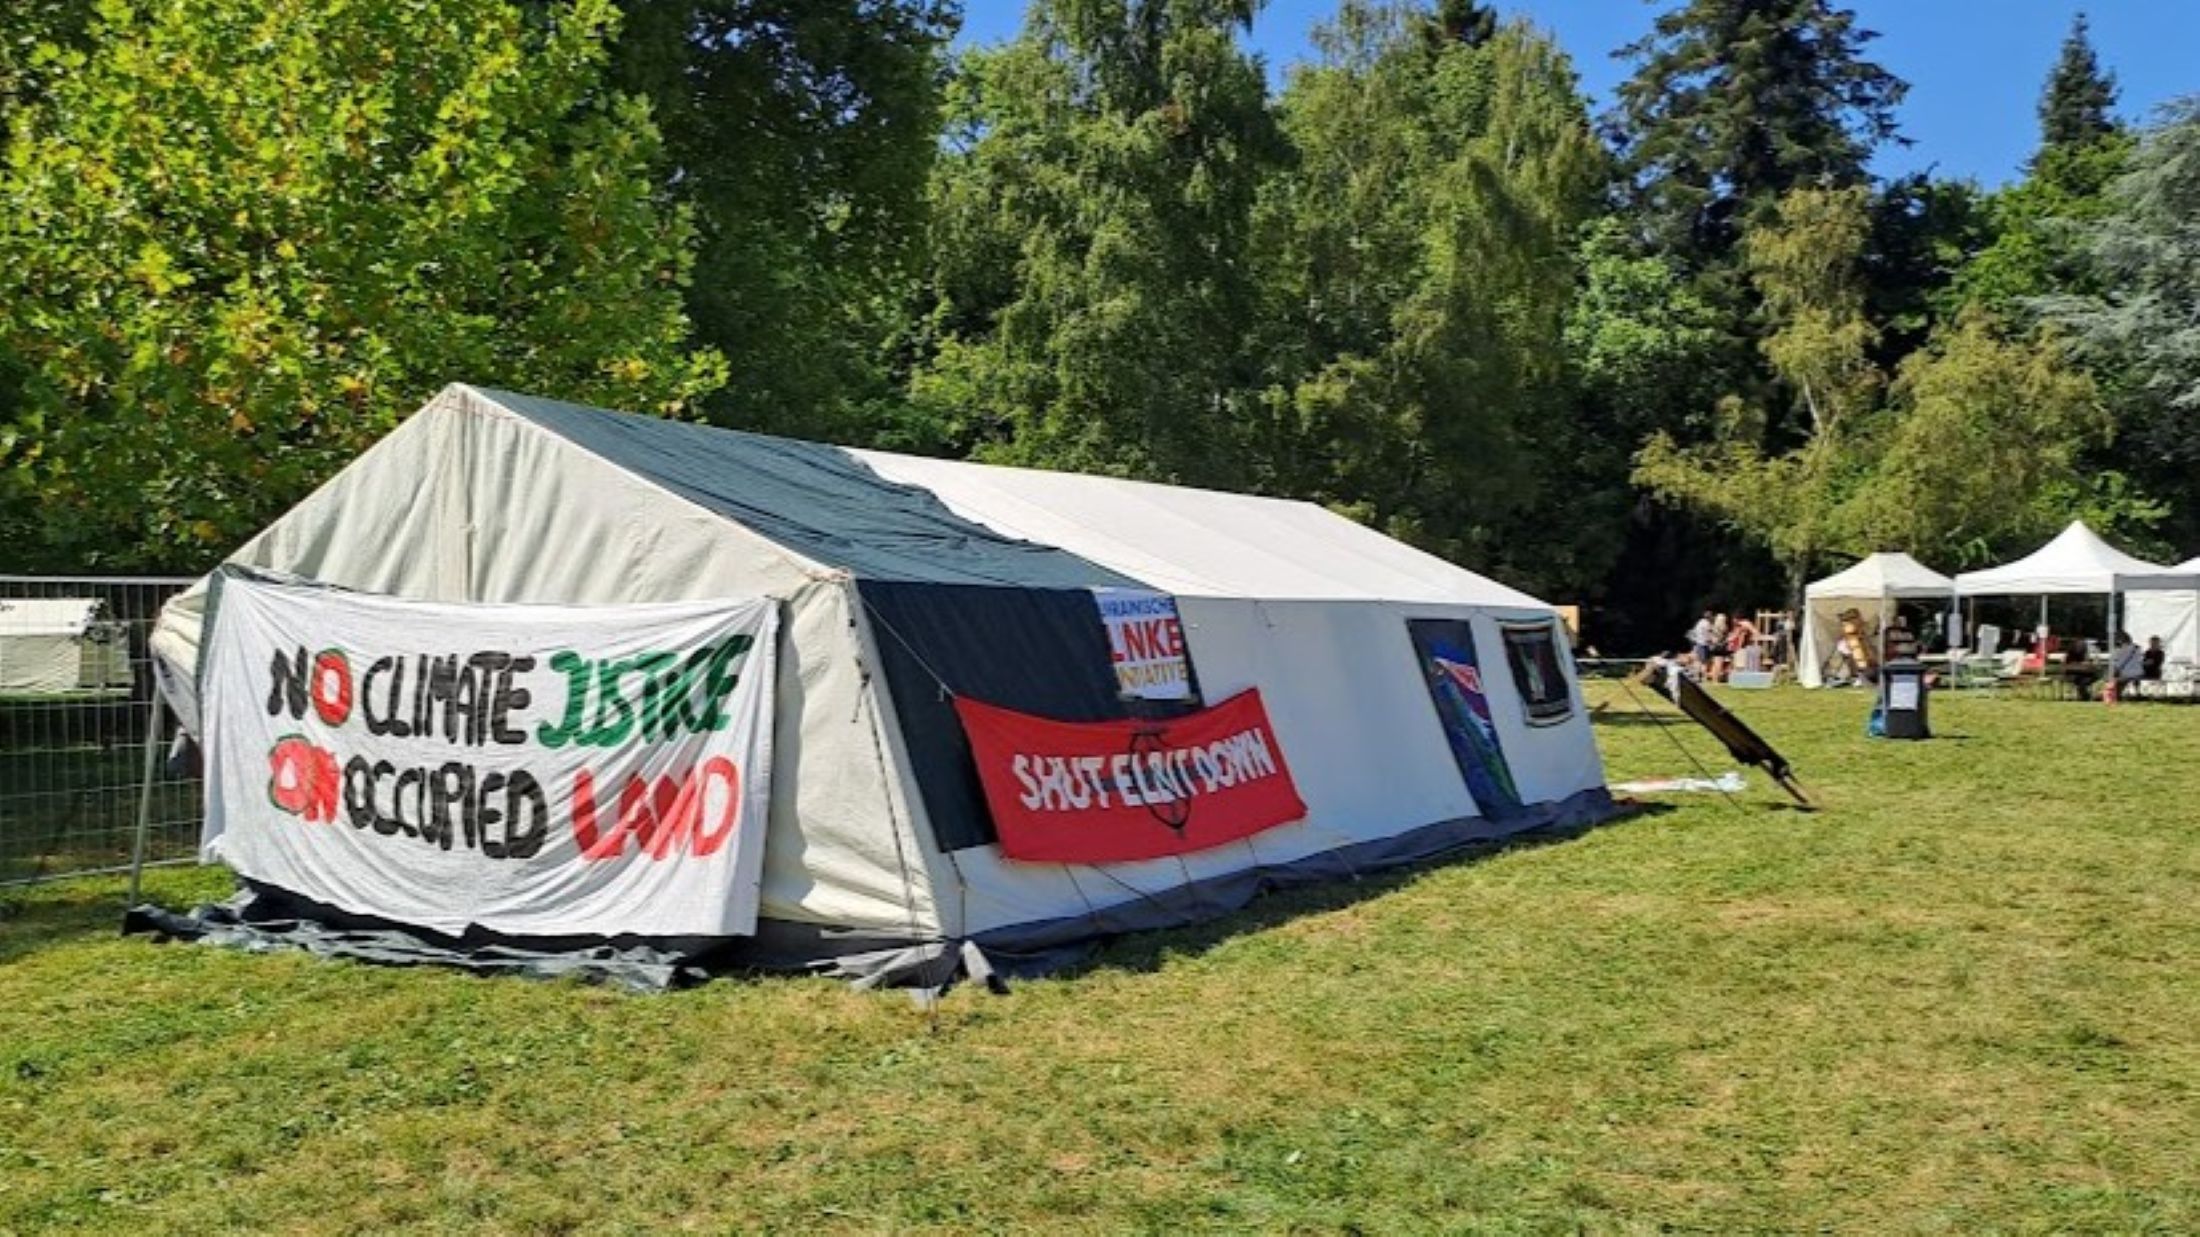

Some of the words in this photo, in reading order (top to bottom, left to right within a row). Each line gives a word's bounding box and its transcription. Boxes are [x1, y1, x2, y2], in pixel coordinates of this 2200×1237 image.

[267, 646, 353, 727] NO
[362, 651, 536, 746] CLIMATE
[537, 634, 755, 747] JUSTICE
[268, 733, 340, 823] ON
[344, 754, 548, 859] OCCUPIED
[571, 756, 740, 861] LAND
[1012, 754, 1110, 811] SHUT
[1192, 727, 1277, 793] DOWN
